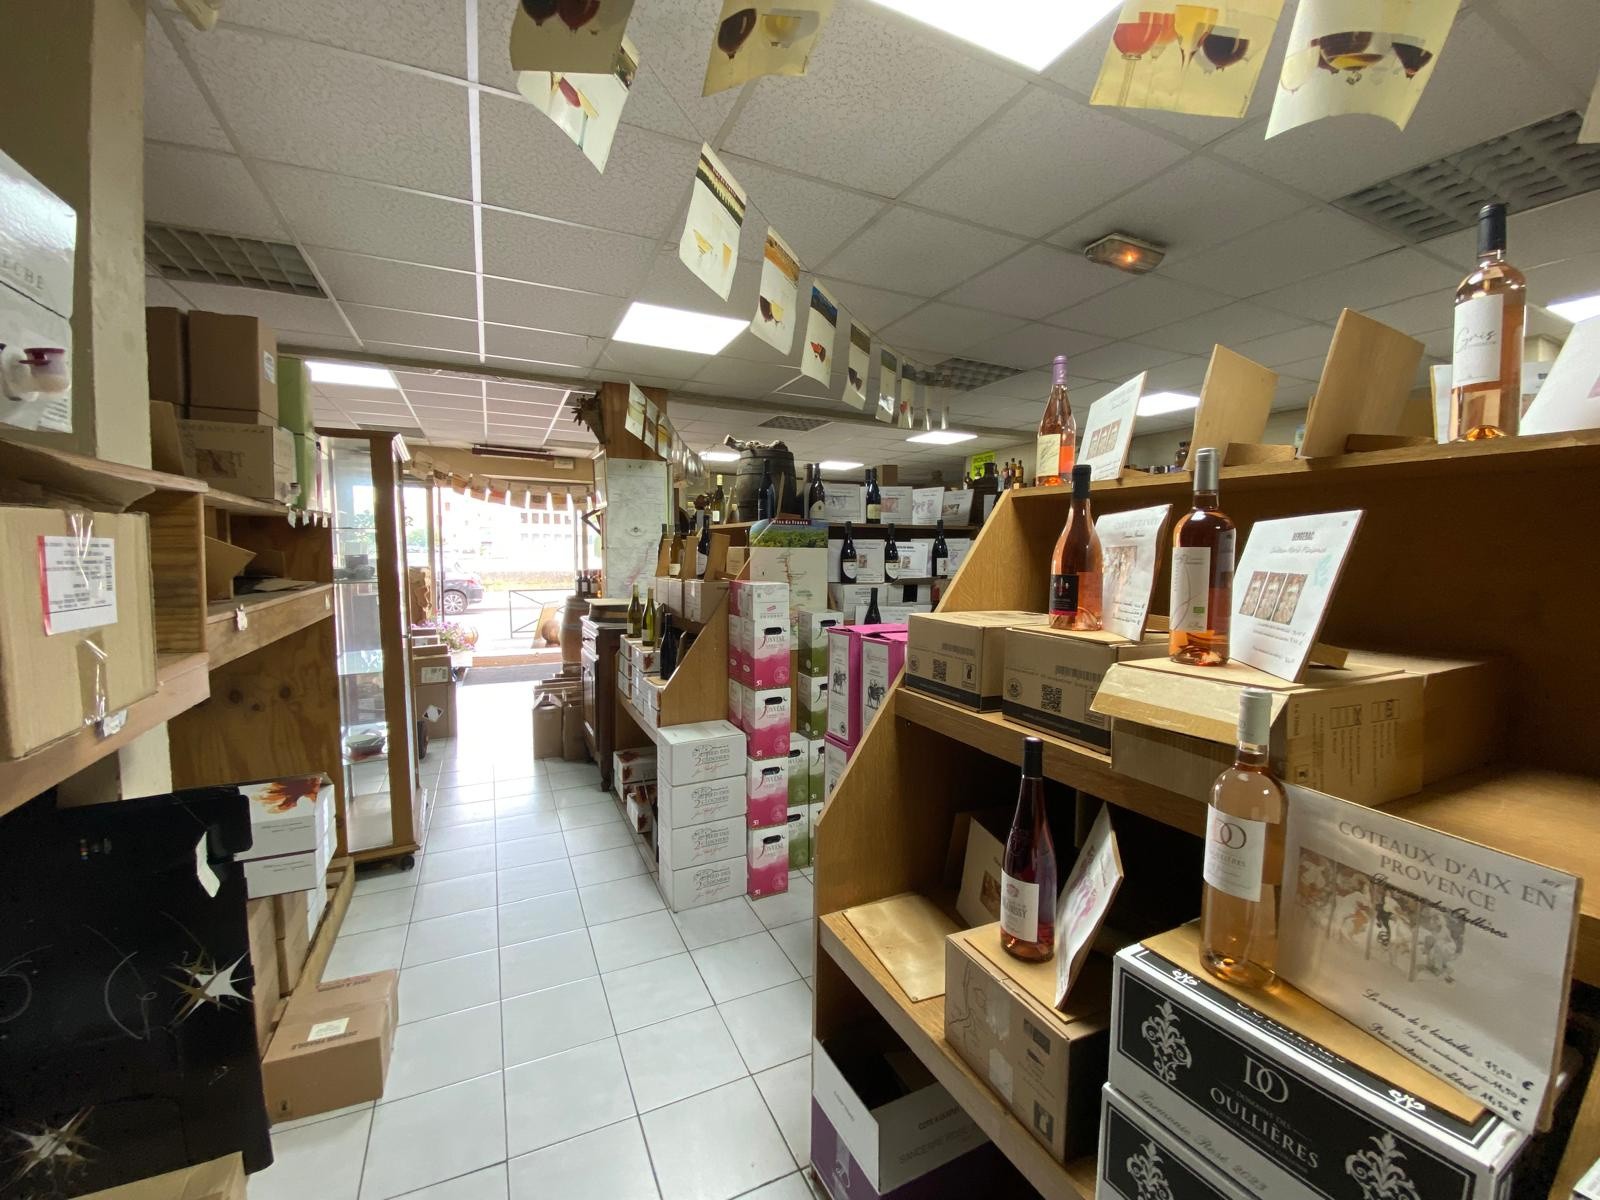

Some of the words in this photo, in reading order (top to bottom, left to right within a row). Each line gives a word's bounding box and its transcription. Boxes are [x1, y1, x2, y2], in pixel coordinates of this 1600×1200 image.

[1338, 821, 1437, 867] COTEAUX
[1446, 857, 1512, 895] D'AIX
[1521, 885, 1558, 911] EN
[1379, 855, 1497, 913] PROVENCE
[1362, 988, 1378, 1002] Le
[1378, 999, 1406, 1019] carton
[1408, 1011, 1419, 1027] de
[1420, 1024, 1428, 1032] 6
[1429, 1028, 1474, 1058] bouteilles
[1244, 1055, 1289, 1103] DO
[1368, 1022, 1391, 1041] Prix
[1391, 1039, 1429, 1065] unitaire
[1429, 1063, 1443, 1075] au
[1511, 1109, 1522, 1121] €
[1518, 1096, 1528, 1105] €
[1521, 1080, 1535, 1091] €
[1210, 1087, 1319, 1169] OULLIÈRES
